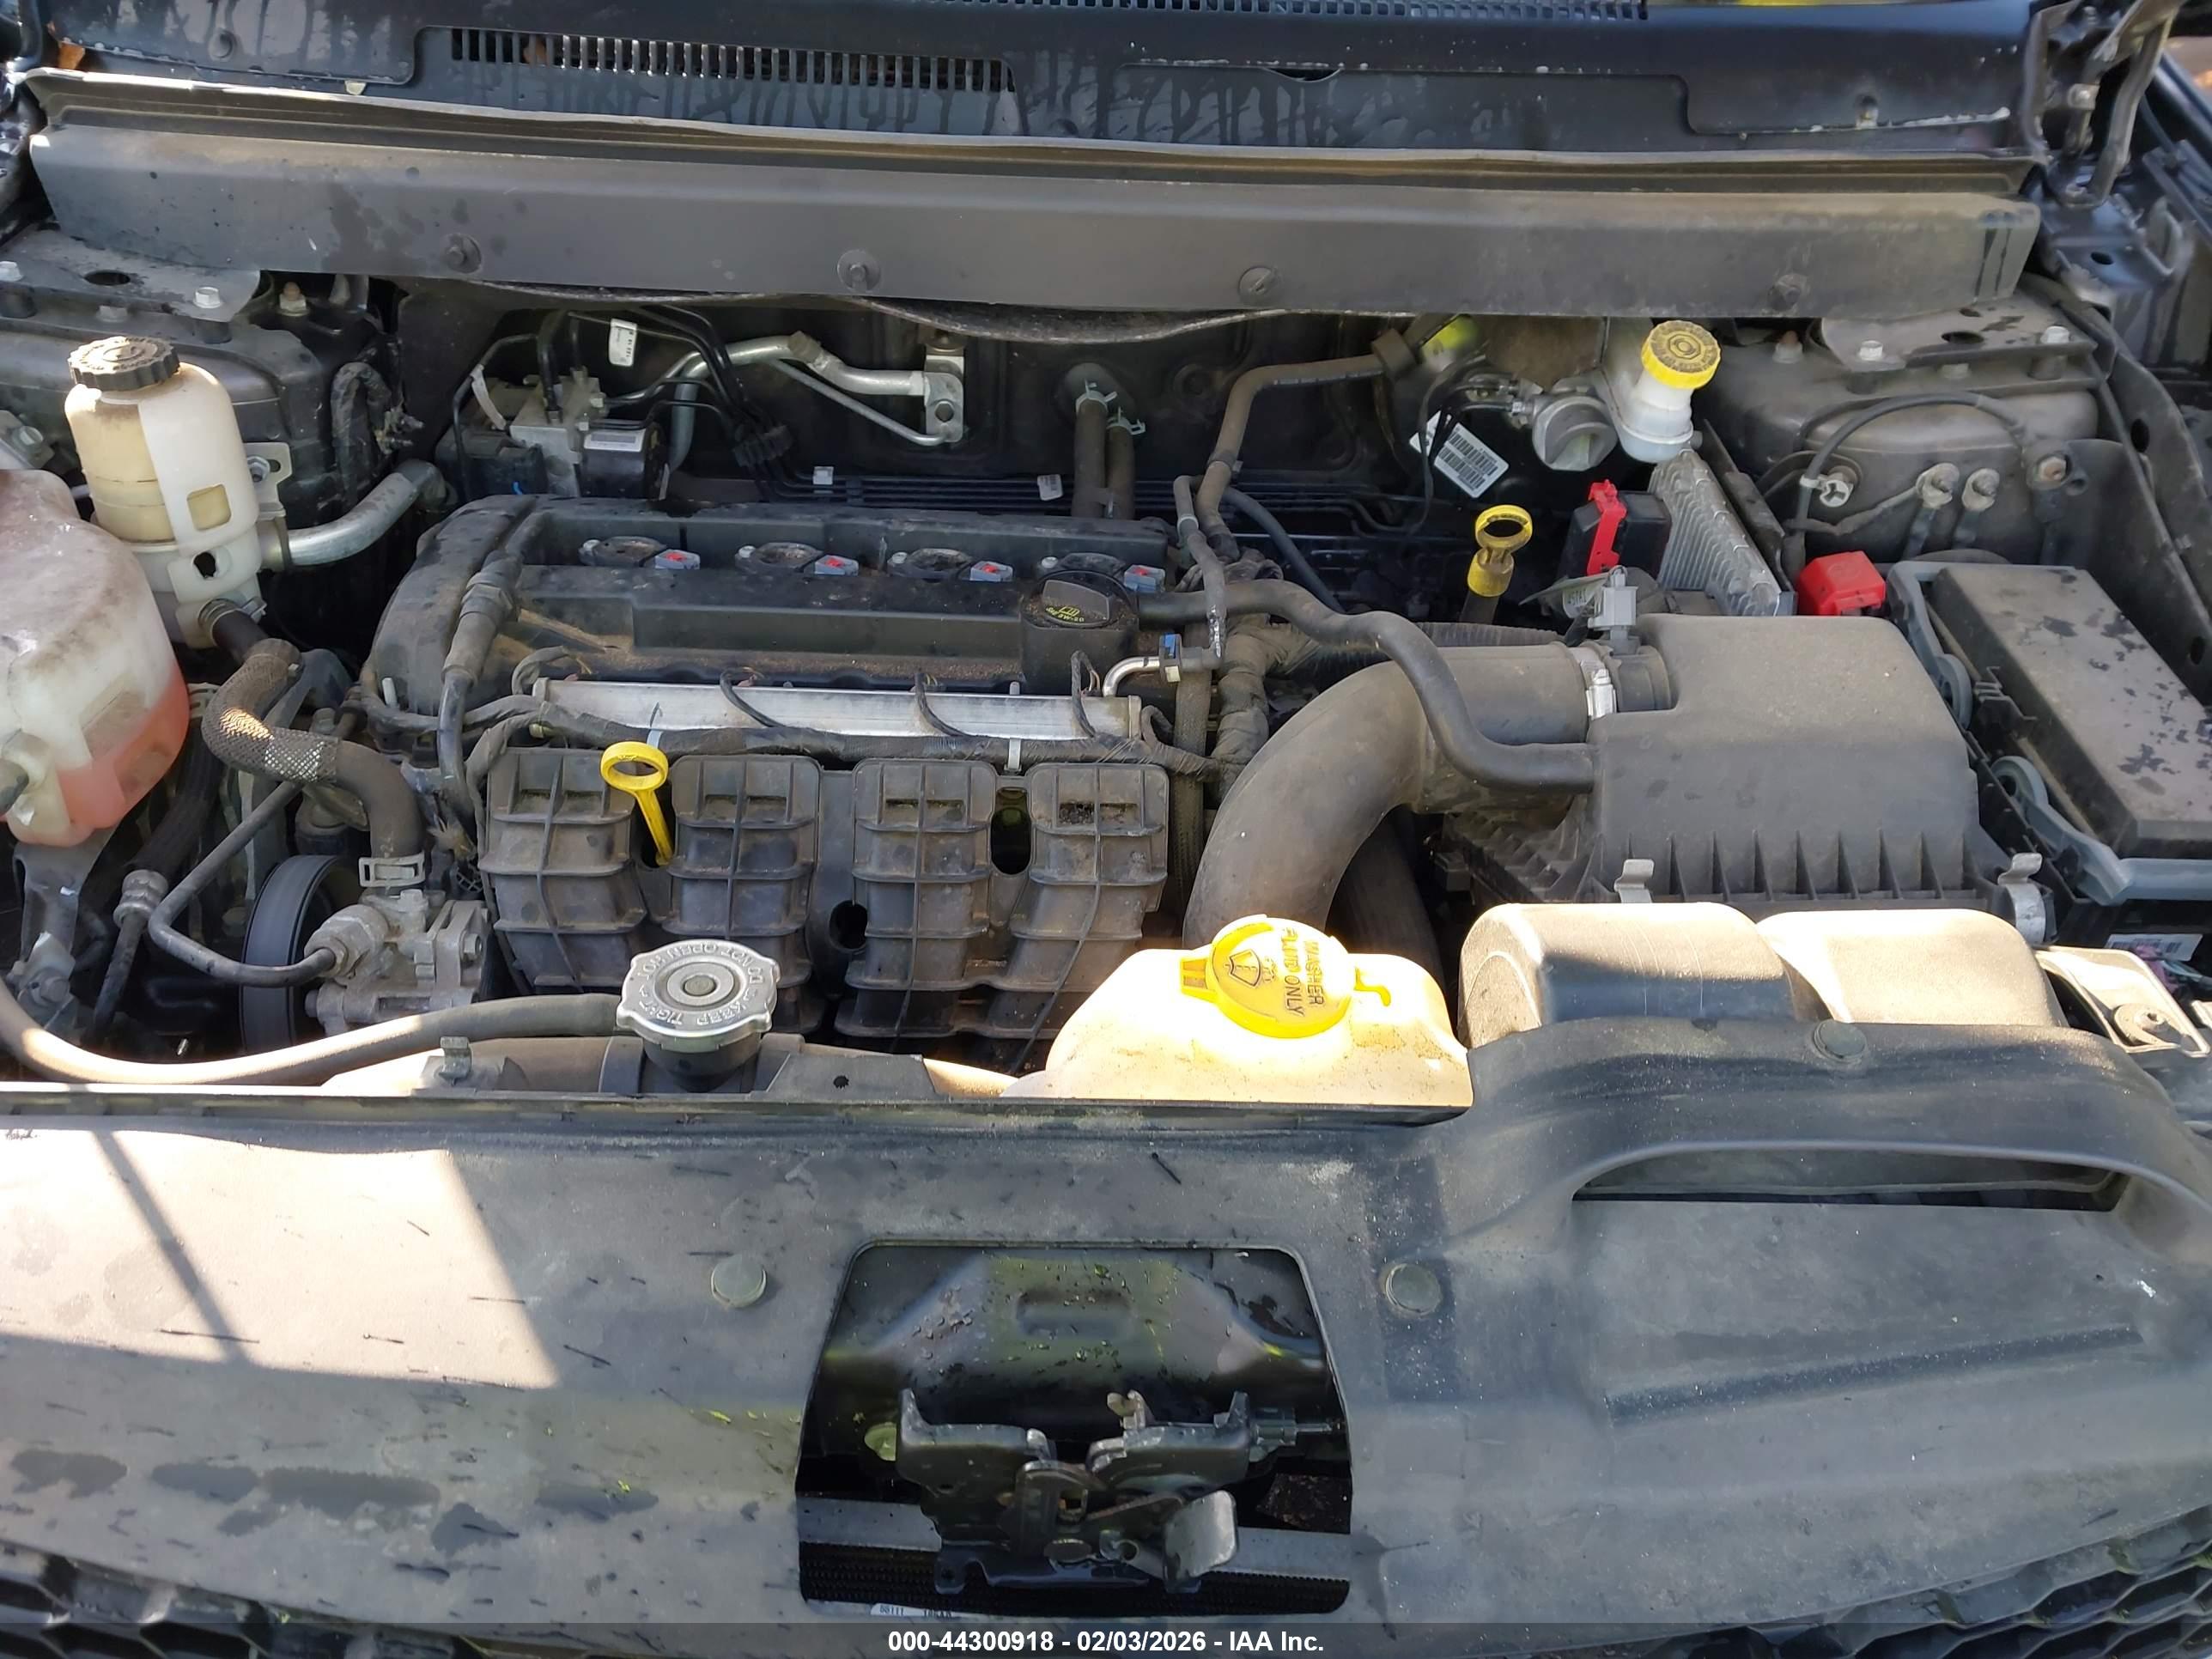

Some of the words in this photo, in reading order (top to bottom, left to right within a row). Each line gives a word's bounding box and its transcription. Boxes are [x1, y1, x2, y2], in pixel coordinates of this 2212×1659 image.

[667, 942, 718, 959] OPEN
[1304, 941, 1324, 1006] WASHER
[696, 1000, 748, 1026] KEEP
[1284, 975, 1304, 1017] ONLY
